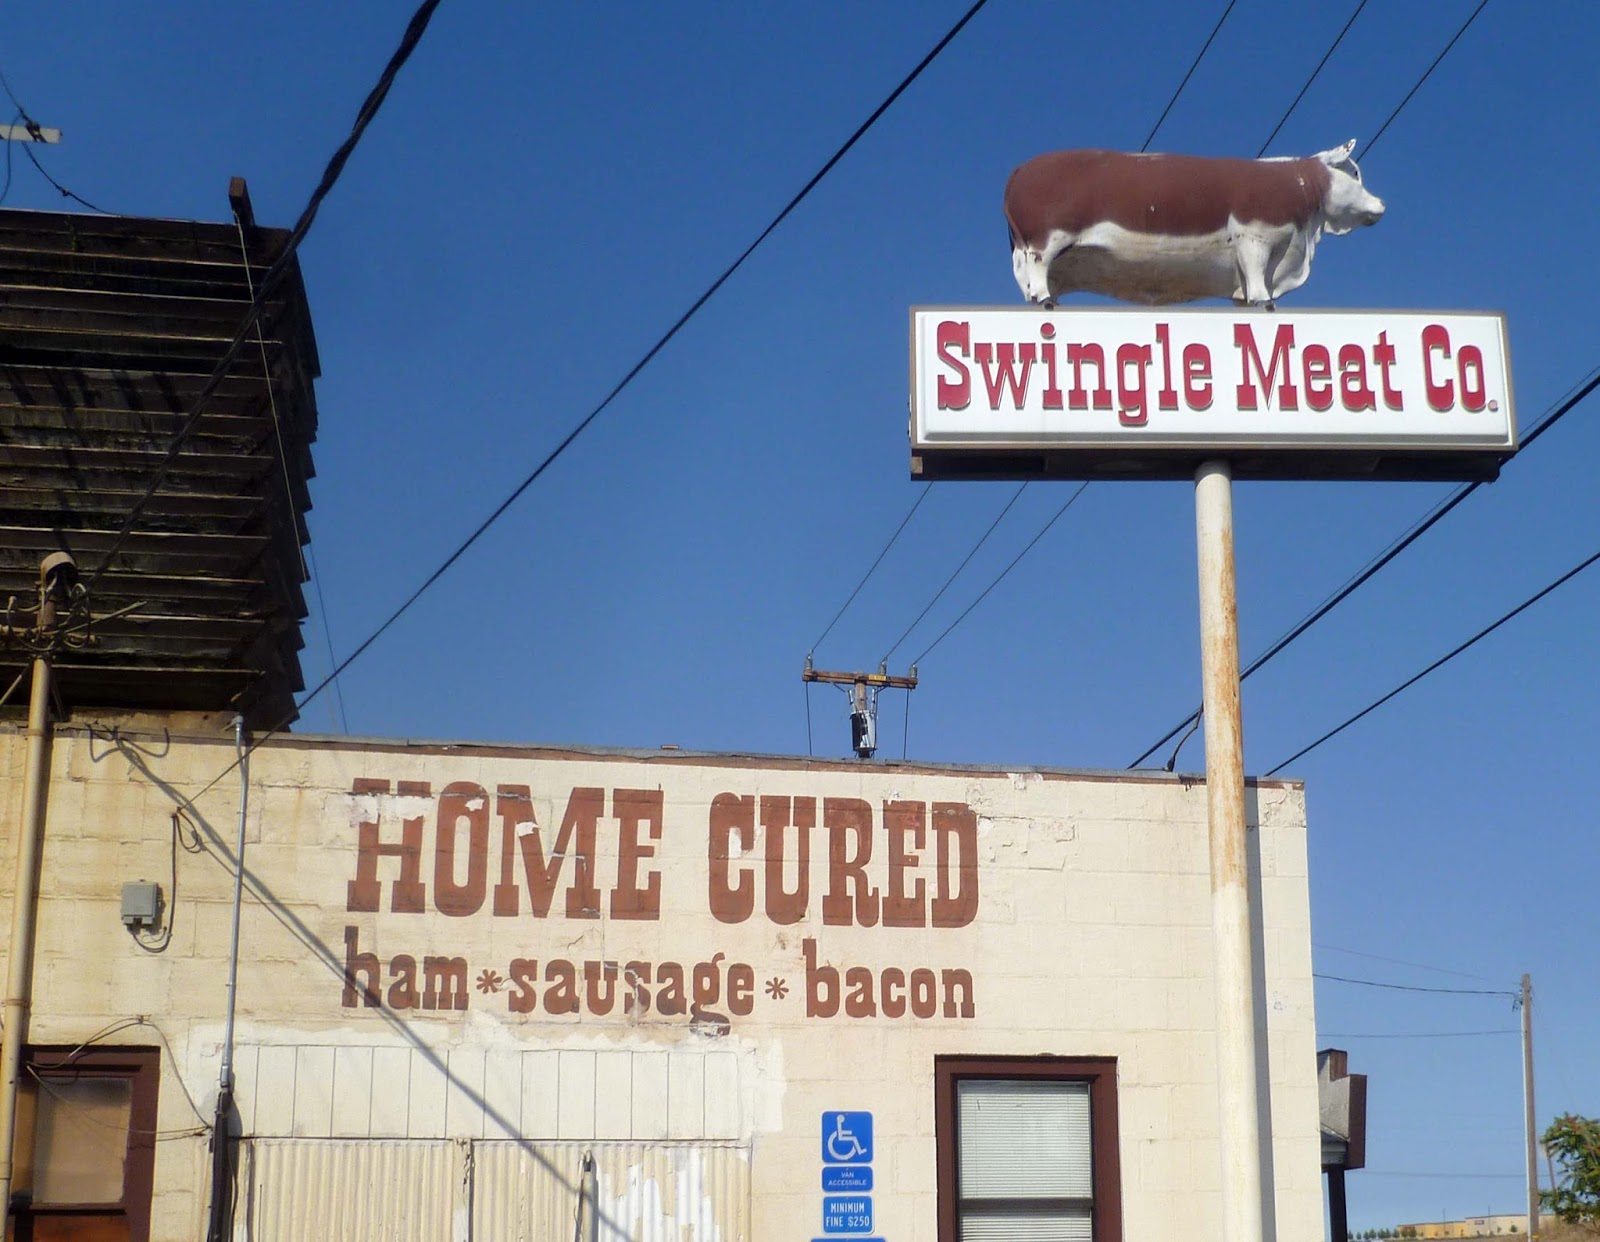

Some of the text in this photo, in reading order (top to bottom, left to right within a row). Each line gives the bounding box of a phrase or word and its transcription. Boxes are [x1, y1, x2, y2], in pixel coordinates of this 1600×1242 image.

[937, 320, 1499, 426] Swingle Meat Co.
[347, 778, 980, 928] HOME CURED
[342, 926, 976, 1037] ham sausage bacon
[826, 1215, 870, 1227] FINE $250
[830, 1202, 865, 1213] MINIMUM
